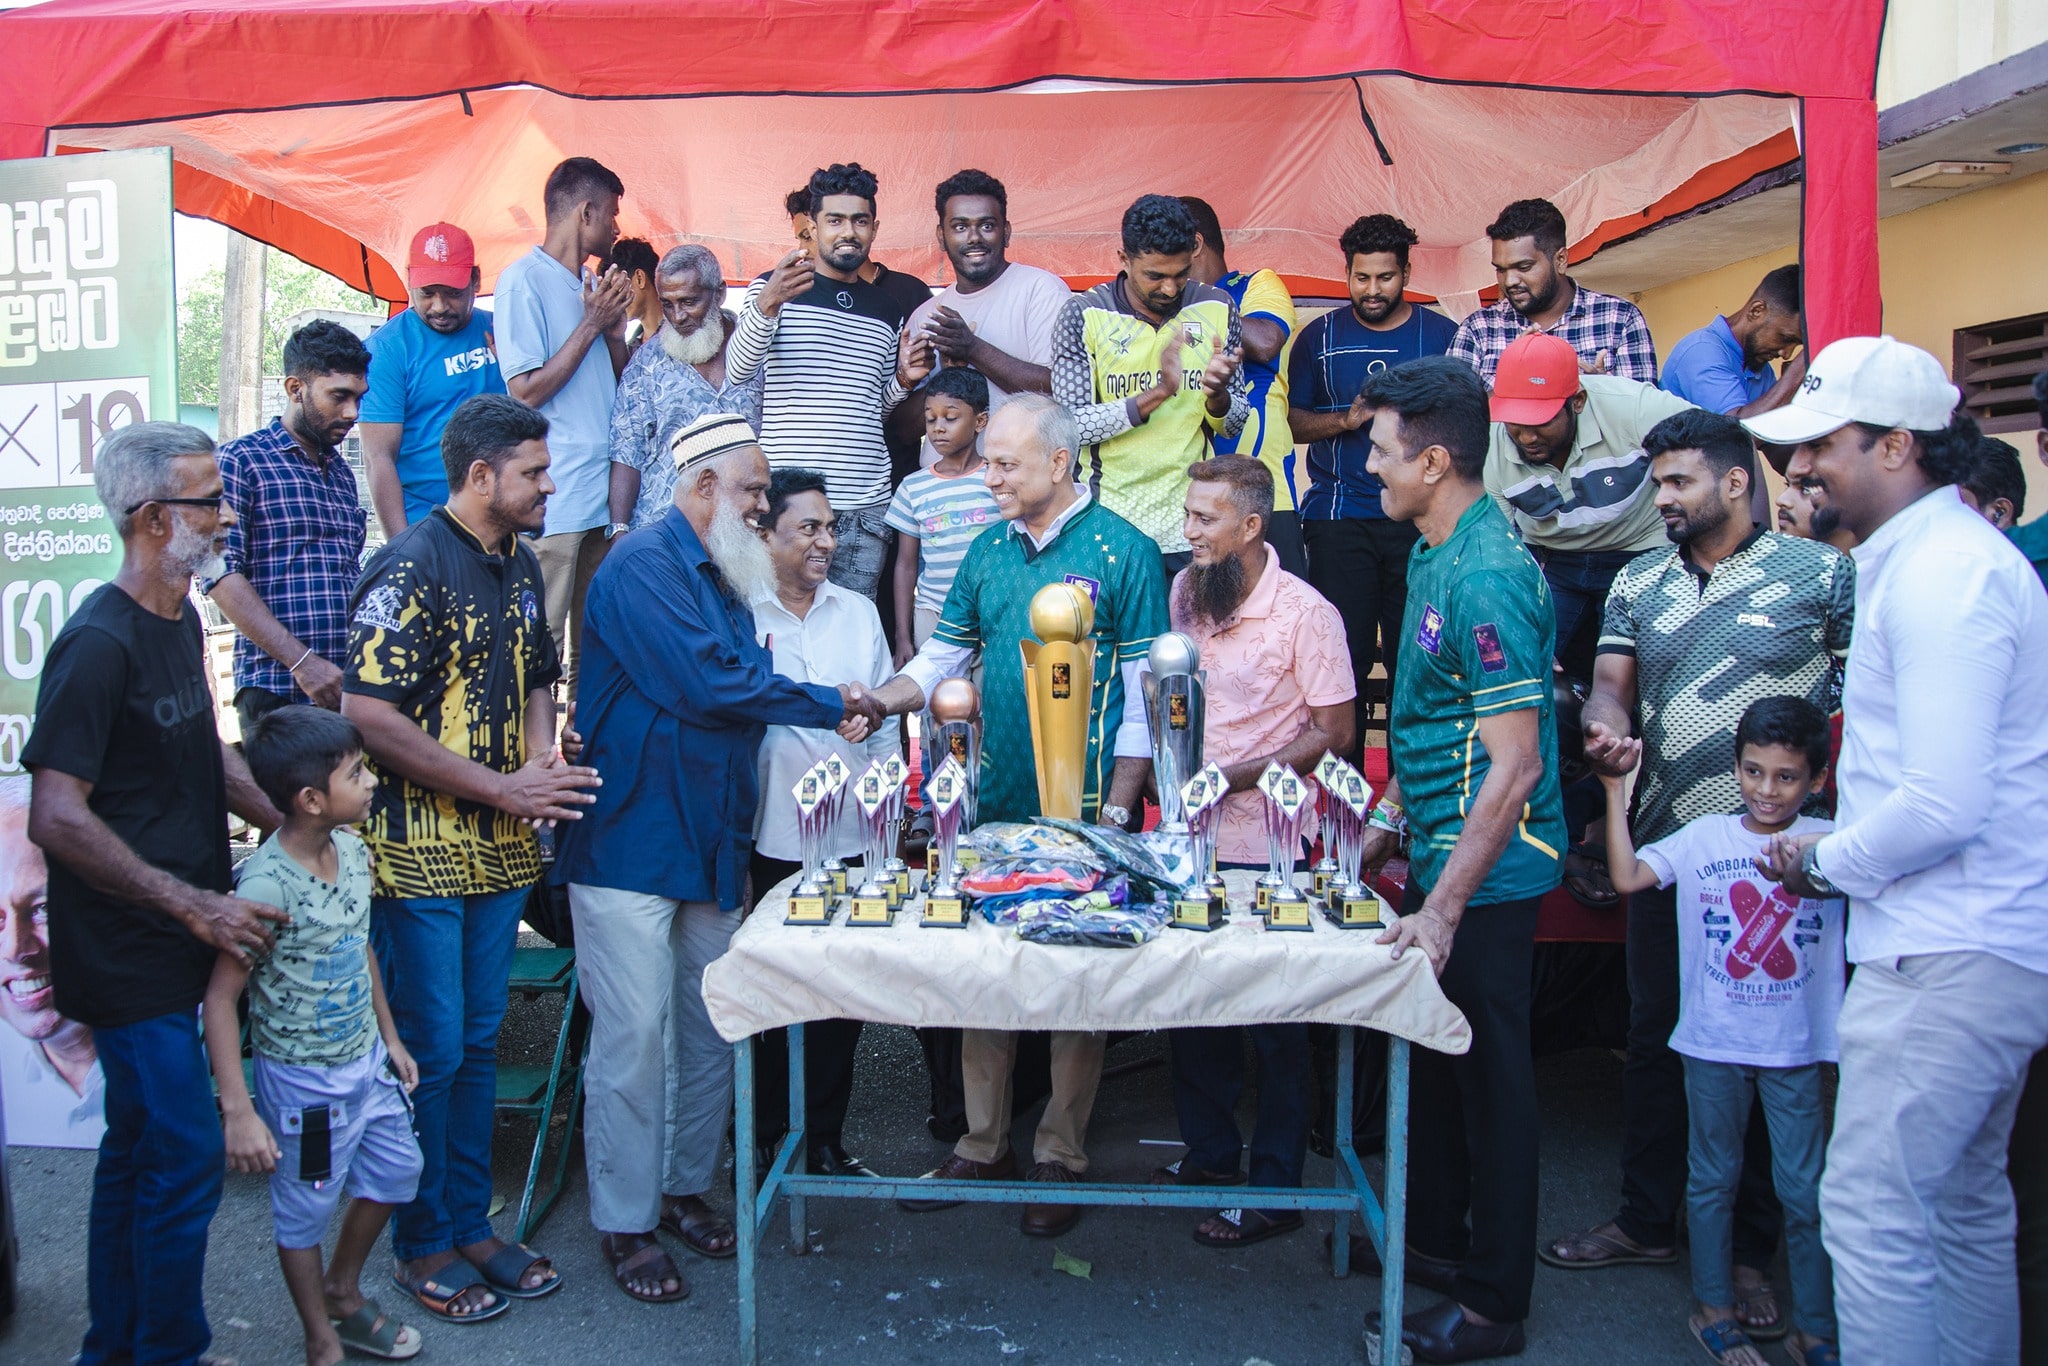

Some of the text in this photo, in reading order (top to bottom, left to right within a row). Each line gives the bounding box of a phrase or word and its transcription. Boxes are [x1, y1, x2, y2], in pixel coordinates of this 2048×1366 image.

[0, 179, 119, 281] සුම
[444, 347, 496, 377] KUSH
[1107, 370, 1152, 399] MASTER
[1803, 374, 1822, 395] ep
[926, 507, 986, 533] STRONG
[1696, 857, 1757, 880] LONGBOAR
[1700, 892, 1724, 906] BREAK
[1733, 980, 1764, 994] STYLE
